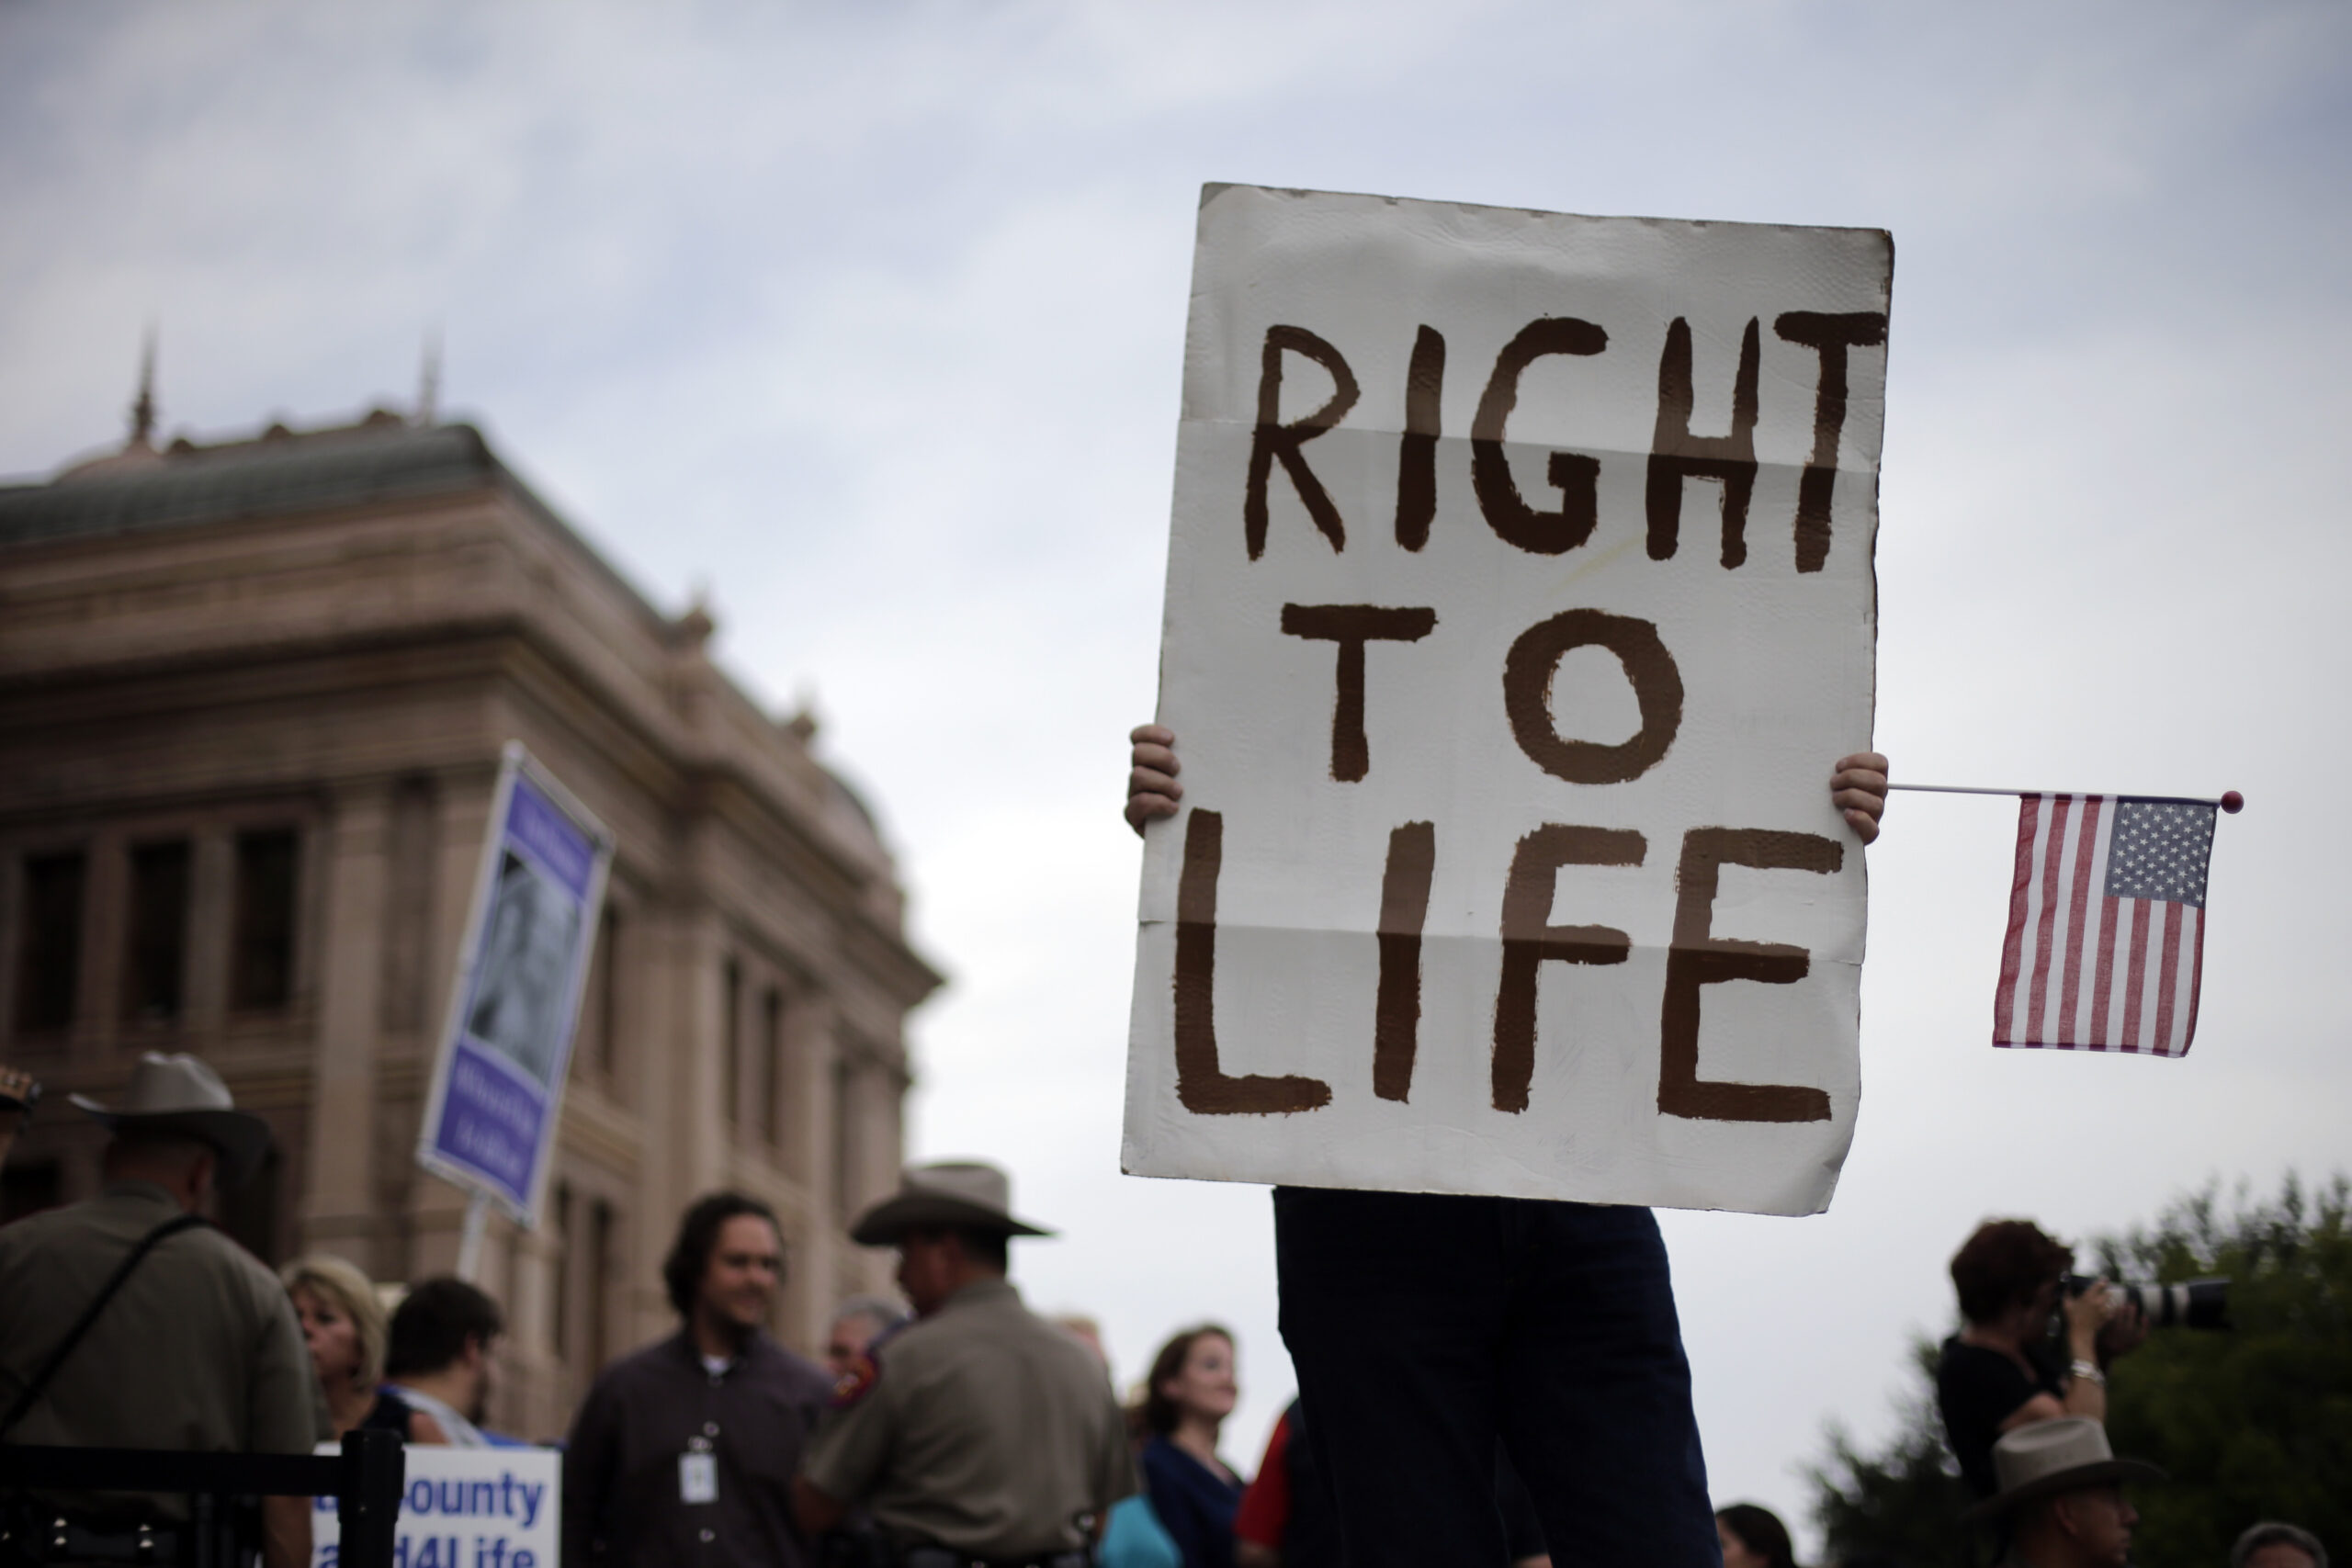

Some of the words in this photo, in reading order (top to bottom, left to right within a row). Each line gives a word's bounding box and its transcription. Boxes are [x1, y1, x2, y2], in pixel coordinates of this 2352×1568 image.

[1245, 310, 1887, 574] RIGHT
[1281, 605, 1684, 785] TO
[1173, 808, 1843, 1122] LIFE
[400, 1472, 546, 1528] ounty
